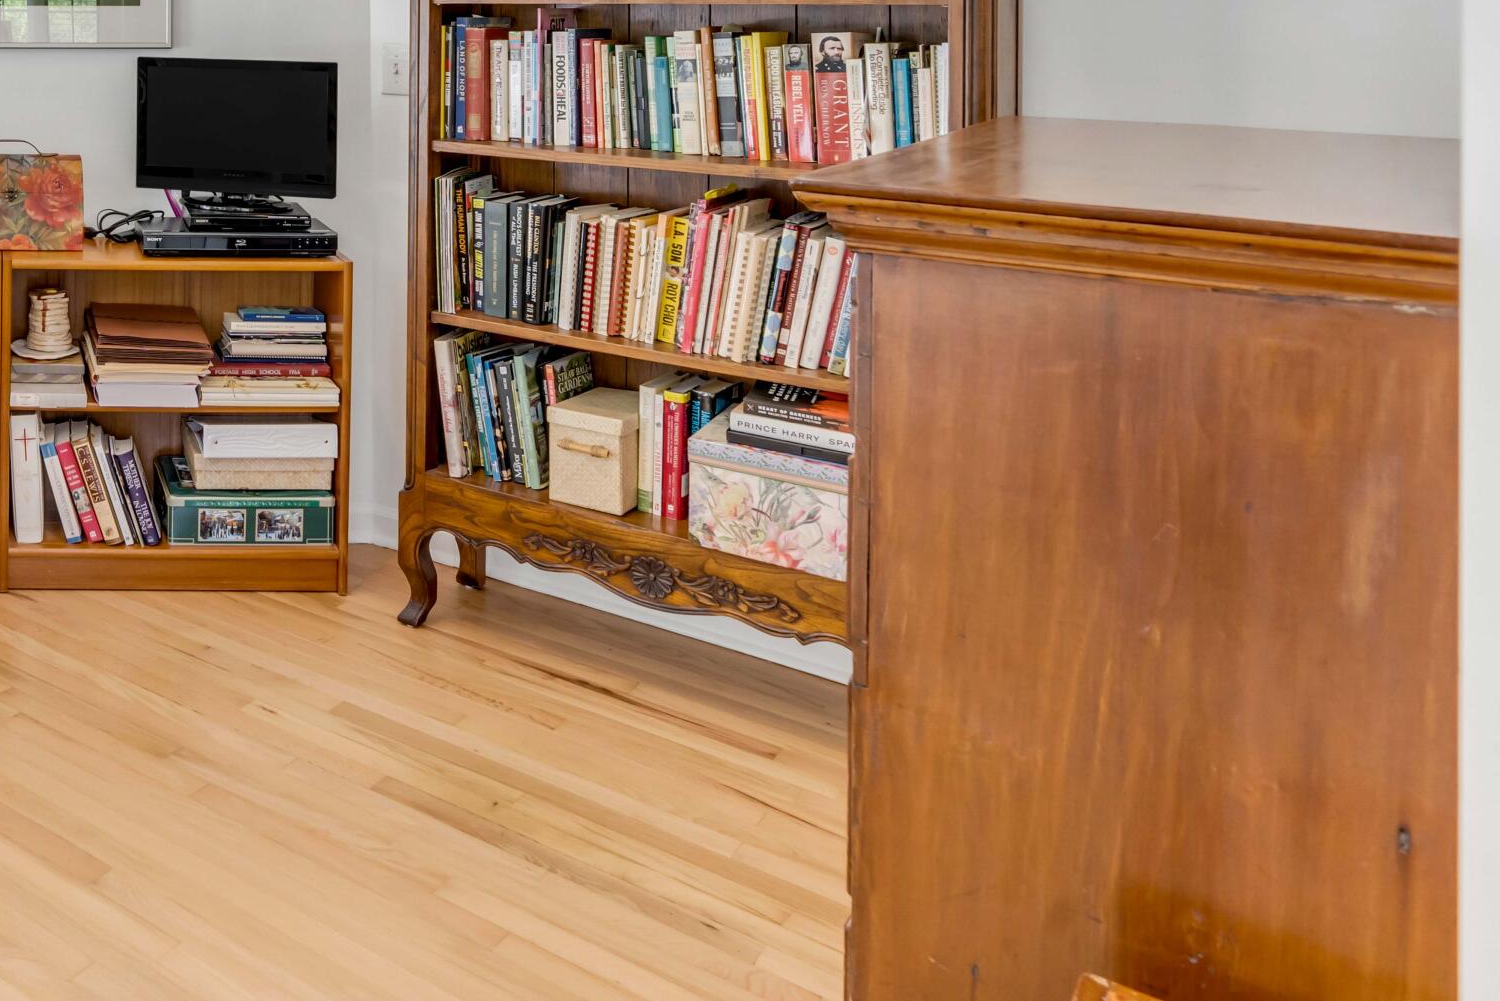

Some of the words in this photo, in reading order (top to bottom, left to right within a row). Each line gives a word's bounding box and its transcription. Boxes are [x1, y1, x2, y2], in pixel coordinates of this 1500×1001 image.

[550, 16, 565, 30] GUT
[495, 46, 503, 58] The
[770, 49, 781, 76] BLOOD
[459, 65, 466, 76] OF
[556, 55, 566, 88] FOODS
[869, 62, 877, 79] Bird
[875, 55, 886, 92] Complete
[458, 79, 466, 102] HOPE
[772, 81, 783, 119] TREASURE
[791, 75, 801, 102] REBEL
[820, 79, 829, 99] RON
[870, 79, 879, 111] Feeding
[556, 97, 566, 123] HEAL
[793, 103, 804, 125] YELL
[833, 79, 850, 148] GRANT
[879, 92, 887, 115] Guide
[821, 100, 831, 146] CHERNOW
[851, 102, 864, 150] INSECTS
[457, 204, 465, 233] HUMAN
[475, 210, 483, 223] JIM
[475, 223, 483, 240] KWIK
[672, 220, 684, 239] L.A.
[475, 249, 483, 279] LIMITLESS
[670, 242, 682, 263] SON
[665, 282, 678, 302] ROY
[662, 303, 674, 327] CHOI
[557, 368, 575, 383] STRAW
[691, 400, 701, 434] PATTERSO
[701, 409, 711, 427] JAM
[757, 405, 778, 413] HEART
[789, 410, 822, 422] DARKNESS
[737, 420, 778, 435] PRINCE
[782, 429, 821, 443] HARRY
[122, 463, 135, 489] TERESA
[129, 459, 142, 490] MOTHER
[513, 454, 523, 478] Mayor
[83, 468, 101, 504] LEWIS
[140, 502, 149, 518] THE
[135, 509, 148, 535] LOVING
[143, 517, 154, 530] JOY
